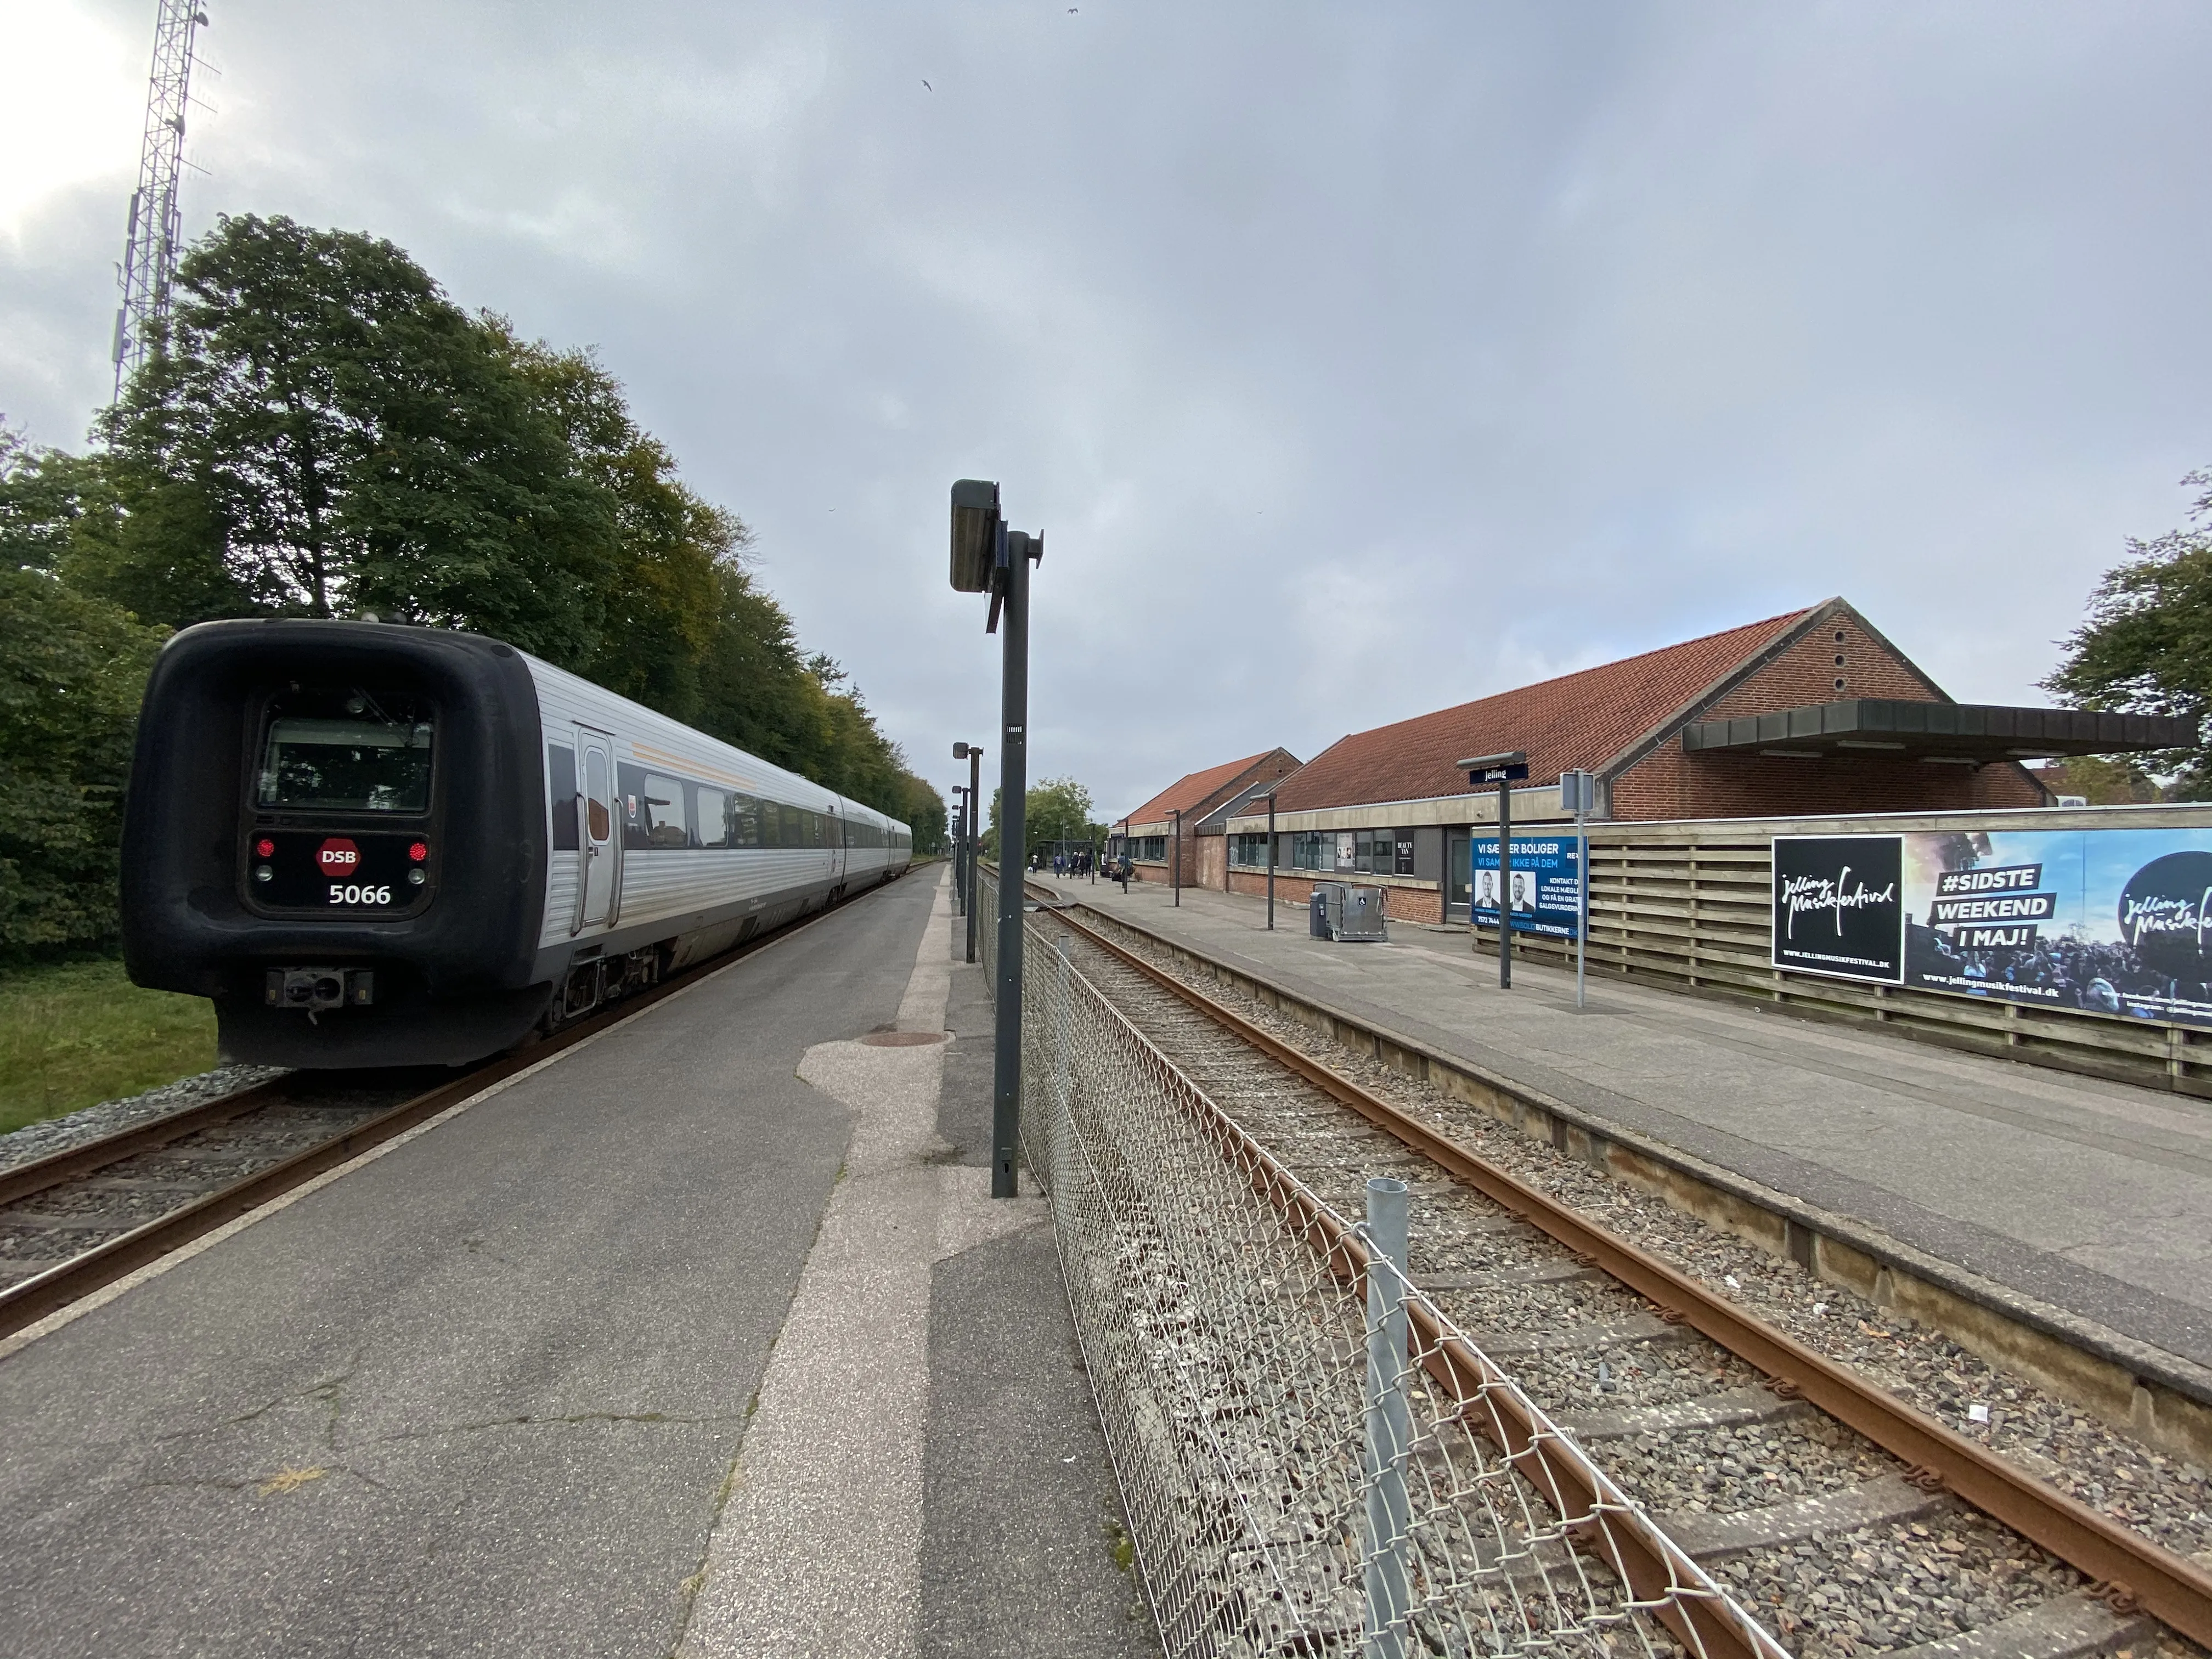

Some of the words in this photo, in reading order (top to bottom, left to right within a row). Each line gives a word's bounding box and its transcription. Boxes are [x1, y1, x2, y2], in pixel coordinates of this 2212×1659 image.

[1485, 770, 1506, 781] Jelling
[322, 851, 356, 864] DSB
[1478, 844, 1486, 853] VI
[1487, 844, 1519, 854] SÆER
[1521, 844, 1559, 854] BOLIGER
[1478, 858, 1485, 866] VI
[1513, 858, 1530, 867] IKKE
[1532, 856, 1540, 867] PÅ
[1542, 859, 1558, 868] DEM
[1942, 868, 2035, 891] #SIDSTE
[329, 885, 391, 904] 5066
[1937, 898, 2047, 919] WEEKEND
[1959, 930, 1966, 947] I
[1973, 929, 2029, 946] MAJ!
[1783, 950, 1890, 968] WWW.JELLINGMUSIKFESTIVAL.DK
[1922, 974, 2059, 997] www.jellingmusikfestival.dk
